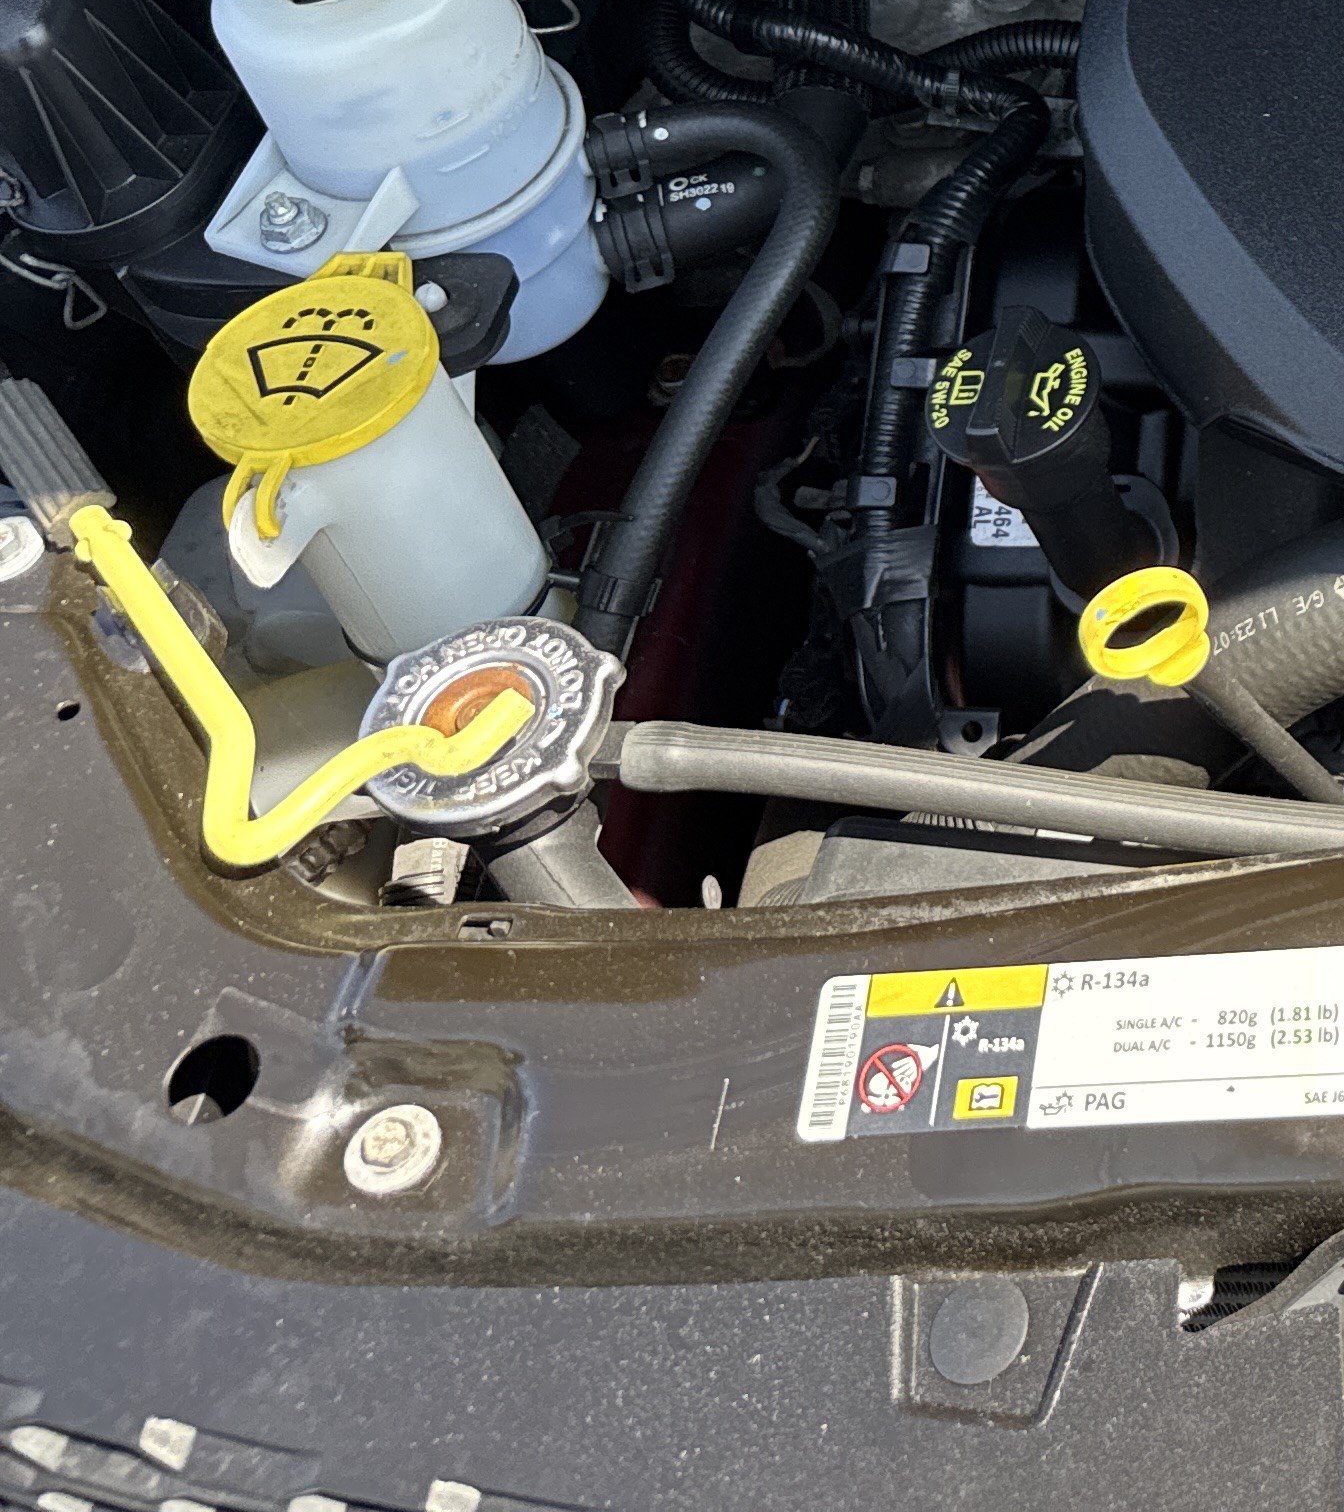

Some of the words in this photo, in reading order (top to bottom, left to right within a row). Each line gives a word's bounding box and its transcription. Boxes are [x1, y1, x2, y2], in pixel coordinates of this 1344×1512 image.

[941, 349, 972, 377] SAE
[1064, 348, 1088, 406] ENGINE
[931, 381, 950, 428] 5W-20
[1041, 407, 1074, 433] OIL
[974, 505, 993, 529] AL
[1081, 971, 1150, 991] R-134a
[1116, 1017, 1157, 1031] SINGLE
[1160, 1016, 1183, 1029] A/C
[1217, 1010, 1257, 1027] 820g
[1270, 1005, 1311, 1025] (1.81
[1316, 1003, 1339, 1023] lb)
[978, 1037, 1025, 1053] R-134a
[1113, 1039, 1145, 1052] DUAL
[1148, 1038, 1171, 1052] A/C
[1205, 1029, 1257, 1051] 1150g
[1270, 1027, 1312, 1048] (2.53
[1316, 1026, 1339, 1046] lb)
[1084, 1091, 1126, 1112] PAG
[1304, 1091, 1328, 1104] SAE
